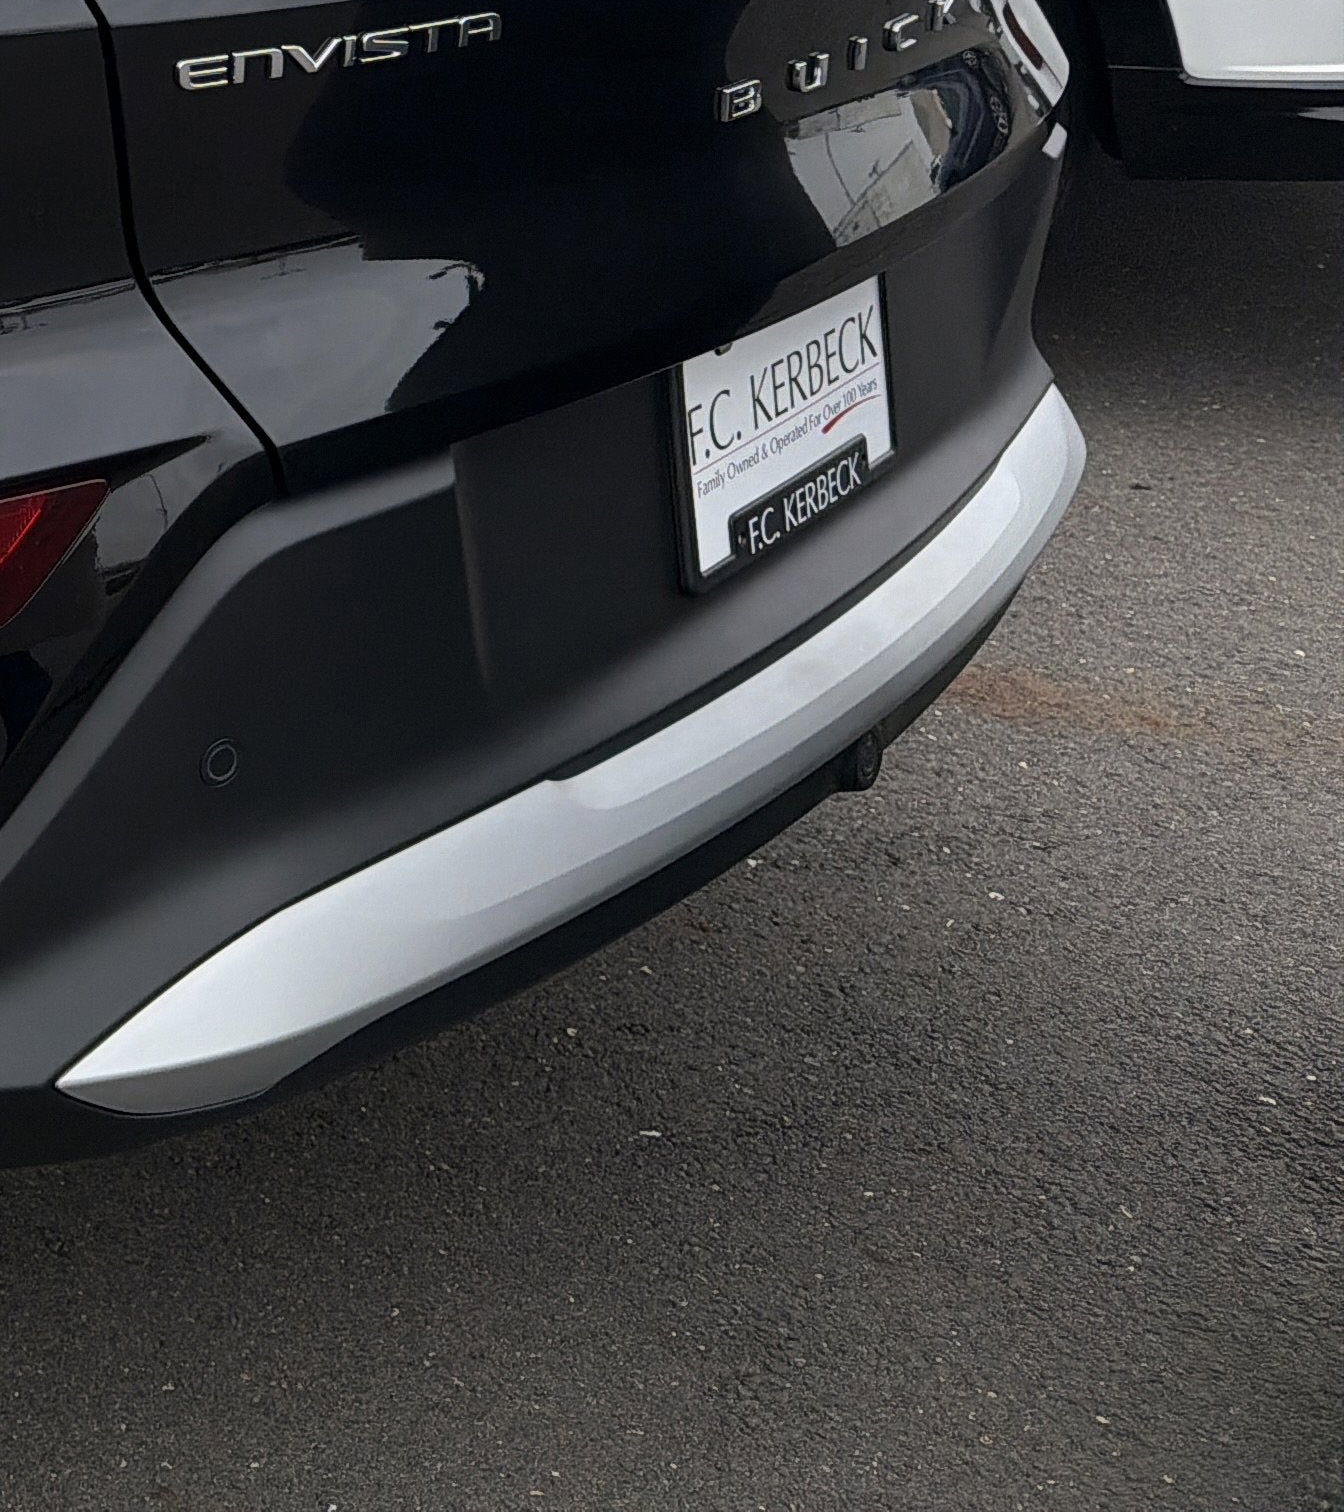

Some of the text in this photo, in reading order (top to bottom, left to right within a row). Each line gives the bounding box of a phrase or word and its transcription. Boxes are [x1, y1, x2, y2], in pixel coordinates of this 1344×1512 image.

[175, 11, 502, 91] ENVISTA
[687, 305, 878, 466] F.C. KERBECK
[697, 377, 878, 499] Family Owned & Operated For Over 100 Years
[748, 451, 862, 555] F.C. KERBECK
